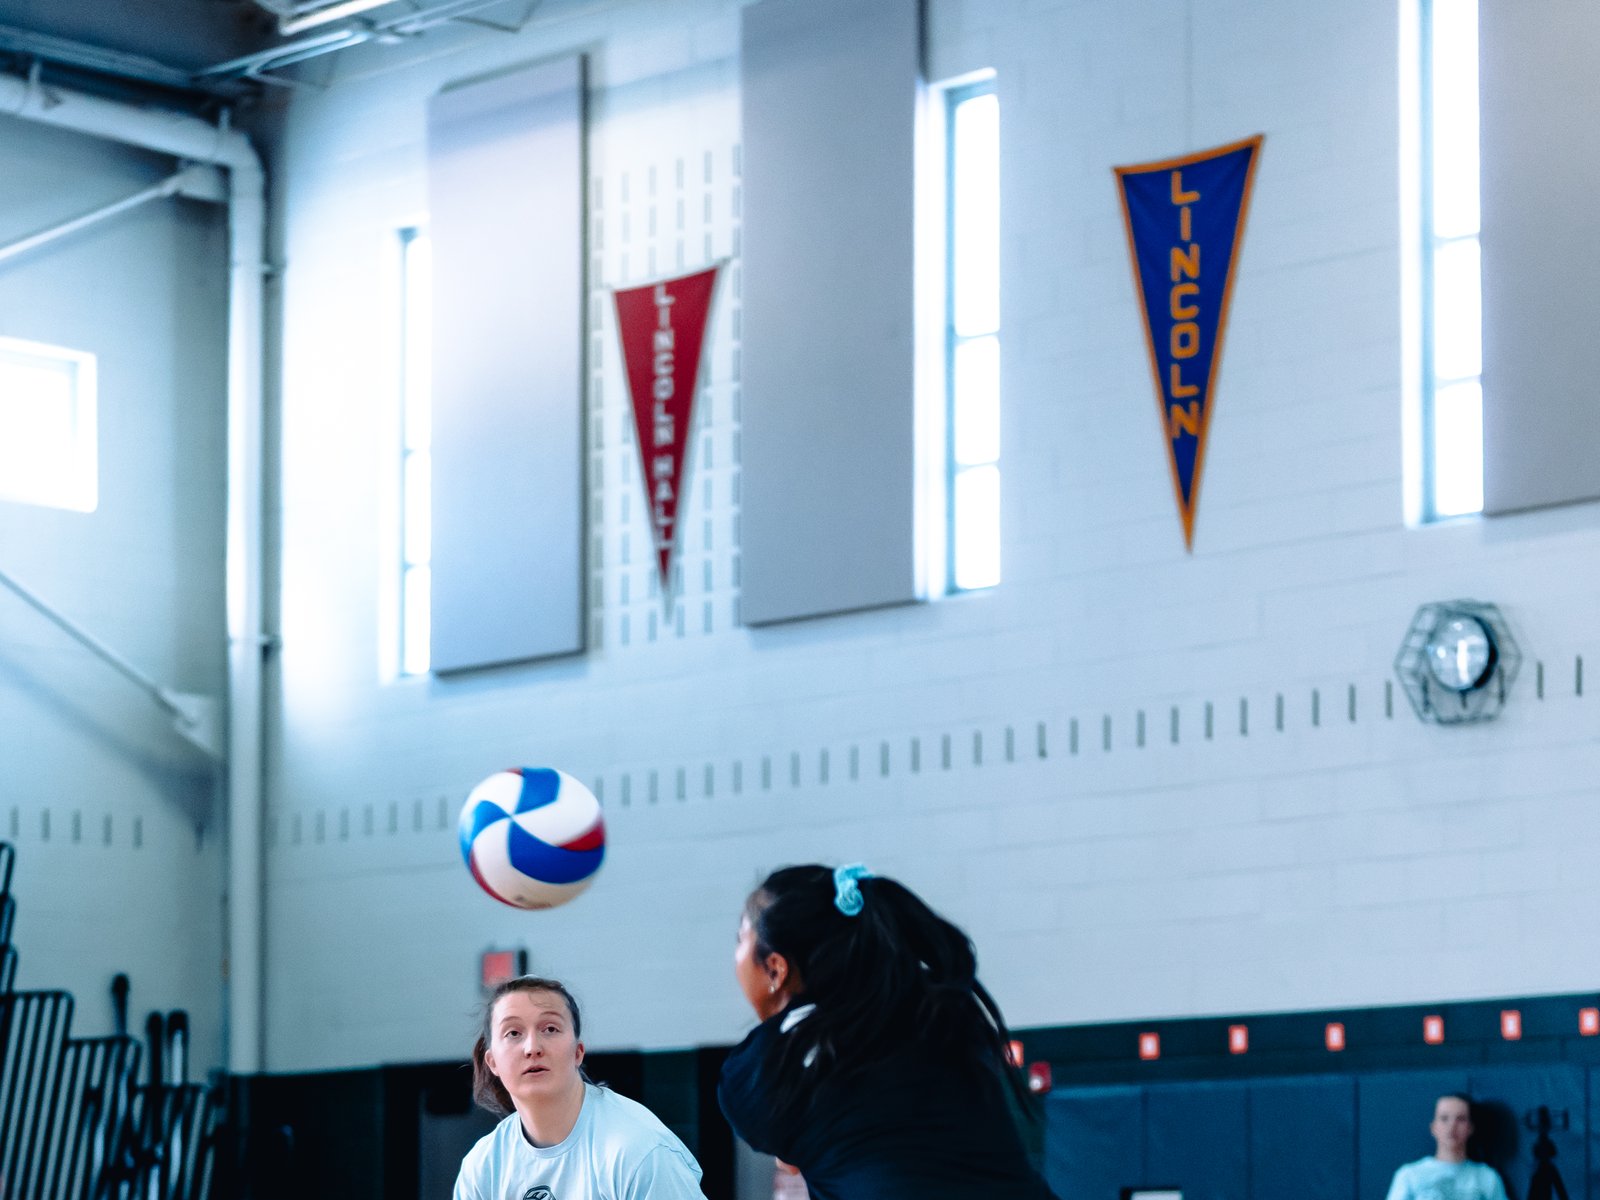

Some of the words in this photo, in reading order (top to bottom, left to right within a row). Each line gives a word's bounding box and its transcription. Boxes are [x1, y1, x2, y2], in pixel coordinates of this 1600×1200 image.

[654, 282, 675, 447] LINCOLN
[1170, 170, 1200, 439] LINCOLN
[654, 455, 676, 550] HALL
